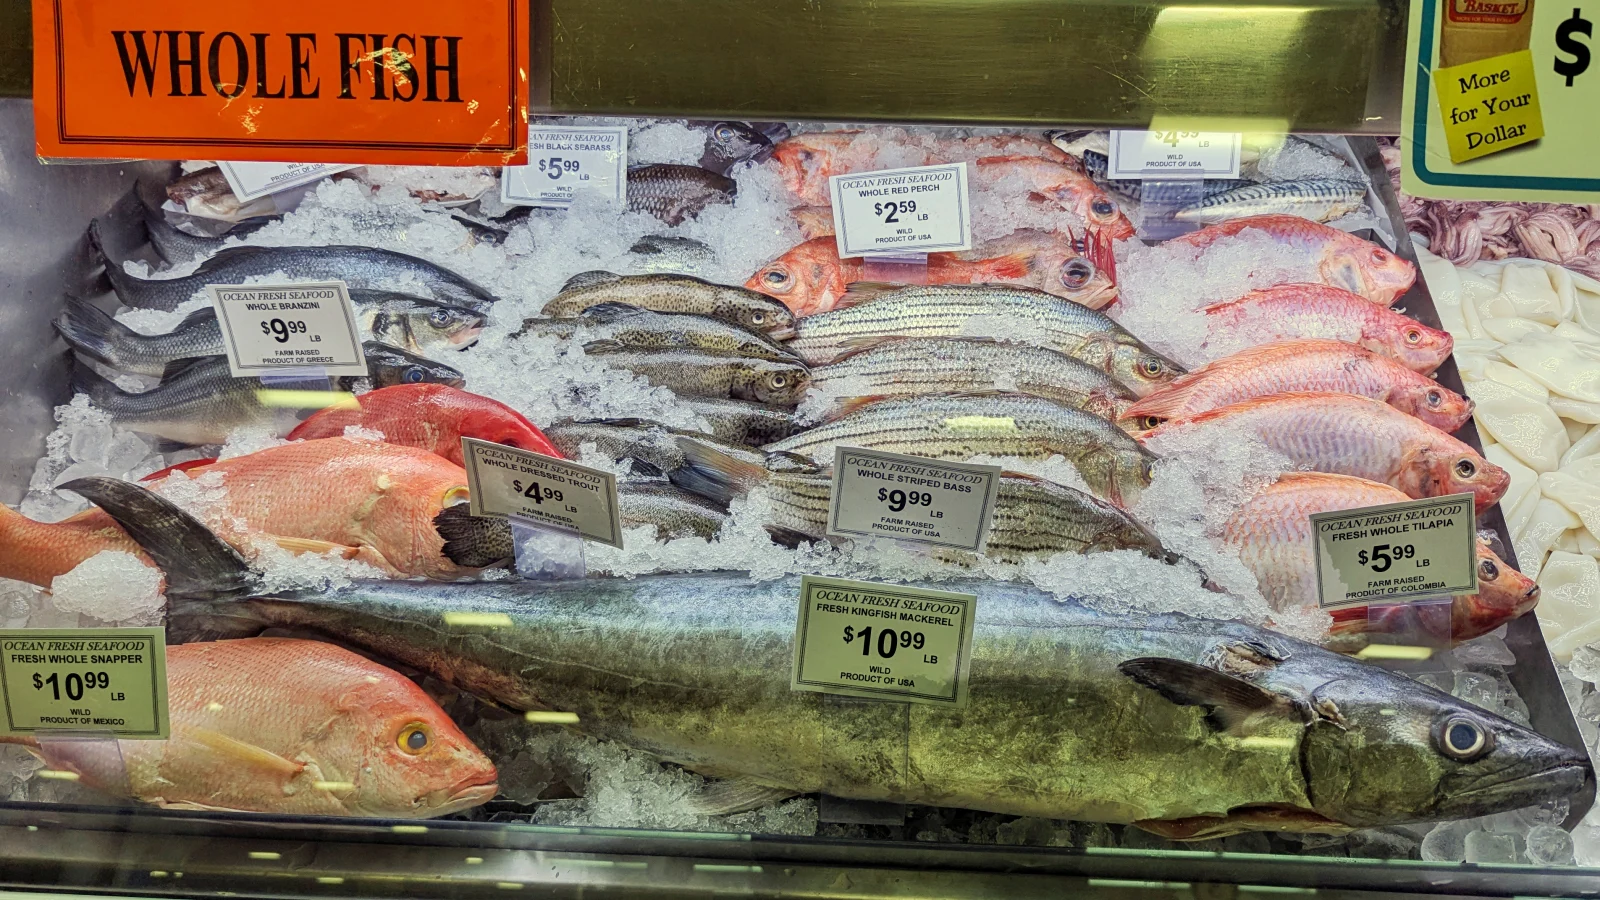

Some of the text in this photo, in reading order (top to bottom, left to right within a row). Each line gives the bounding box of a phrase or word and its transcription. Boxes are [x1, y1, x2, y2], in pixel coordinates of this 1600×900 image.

[111, 30, 463, 103] WHOLE FISH
[1459, 69, 1510, 94] More
[1450, 93, 1531, 125] for Your
[1466, 123, 1526, 150] Dollar
[271, 170, 301, 181] PRODUCT
[842, 173, 952, 189] OCEAN FRESH SEAFOOD
[859, 189, 889, 197] WHOLE
[911, 184, 940, 192] PERCH
[223, 291, 334, 301] OCEAN FRESH SEAFOOD
[279, 302, 320, 310] BRANZINI
[476, 448, 601, 484] OCEAN FRESH SEAFOOD
[847, 457, 983, 485] OCEAN FRESH SEAFOOD
[482, 457, 600, 492] WHOLE DRESSED TROUT
[857, 469, 972, 493] WHOLE STRIPED BASS
[522, 507, 573, 523] FARM RAISED
[565, 505, 577, 513] LB
[930, 511, 943, 519] LB
[881, 517, 935, 529] FARM RAISED
[1321, 505, 1462, 532] OCEAN FRESH SEAFOOD
[872, 523, 910, 534] PRODUCT
[924, 530, 941, 538] USA
[1332, 519, 1454, 542] FRESH WHOLE TILAPIA
[1416, 559, 1430, 568] LB
[1368, 576, 1425, 588] FARM RAISED
[1346, 588, 1386, 599] PRODUCT
[1401, 582, 1446, 593] COLOMBIA
[816, 590, 960, 615] OCEAN FRESH SEAFOOD
[816, 603, 954, 626] FRESH KINGFISH MACKEREL
[4, 641, 145, 651] OCEAN FRESH SEAFOOD
[12, 655, 143, 663] FRESH WHOLE SNAPPER
[923, 654, 938, 664] LB
[869, 665, 891, 674] WILD
[840, 672, 915, 687] PRODUCT OF USA
[111, 692, 125, 701] LB
